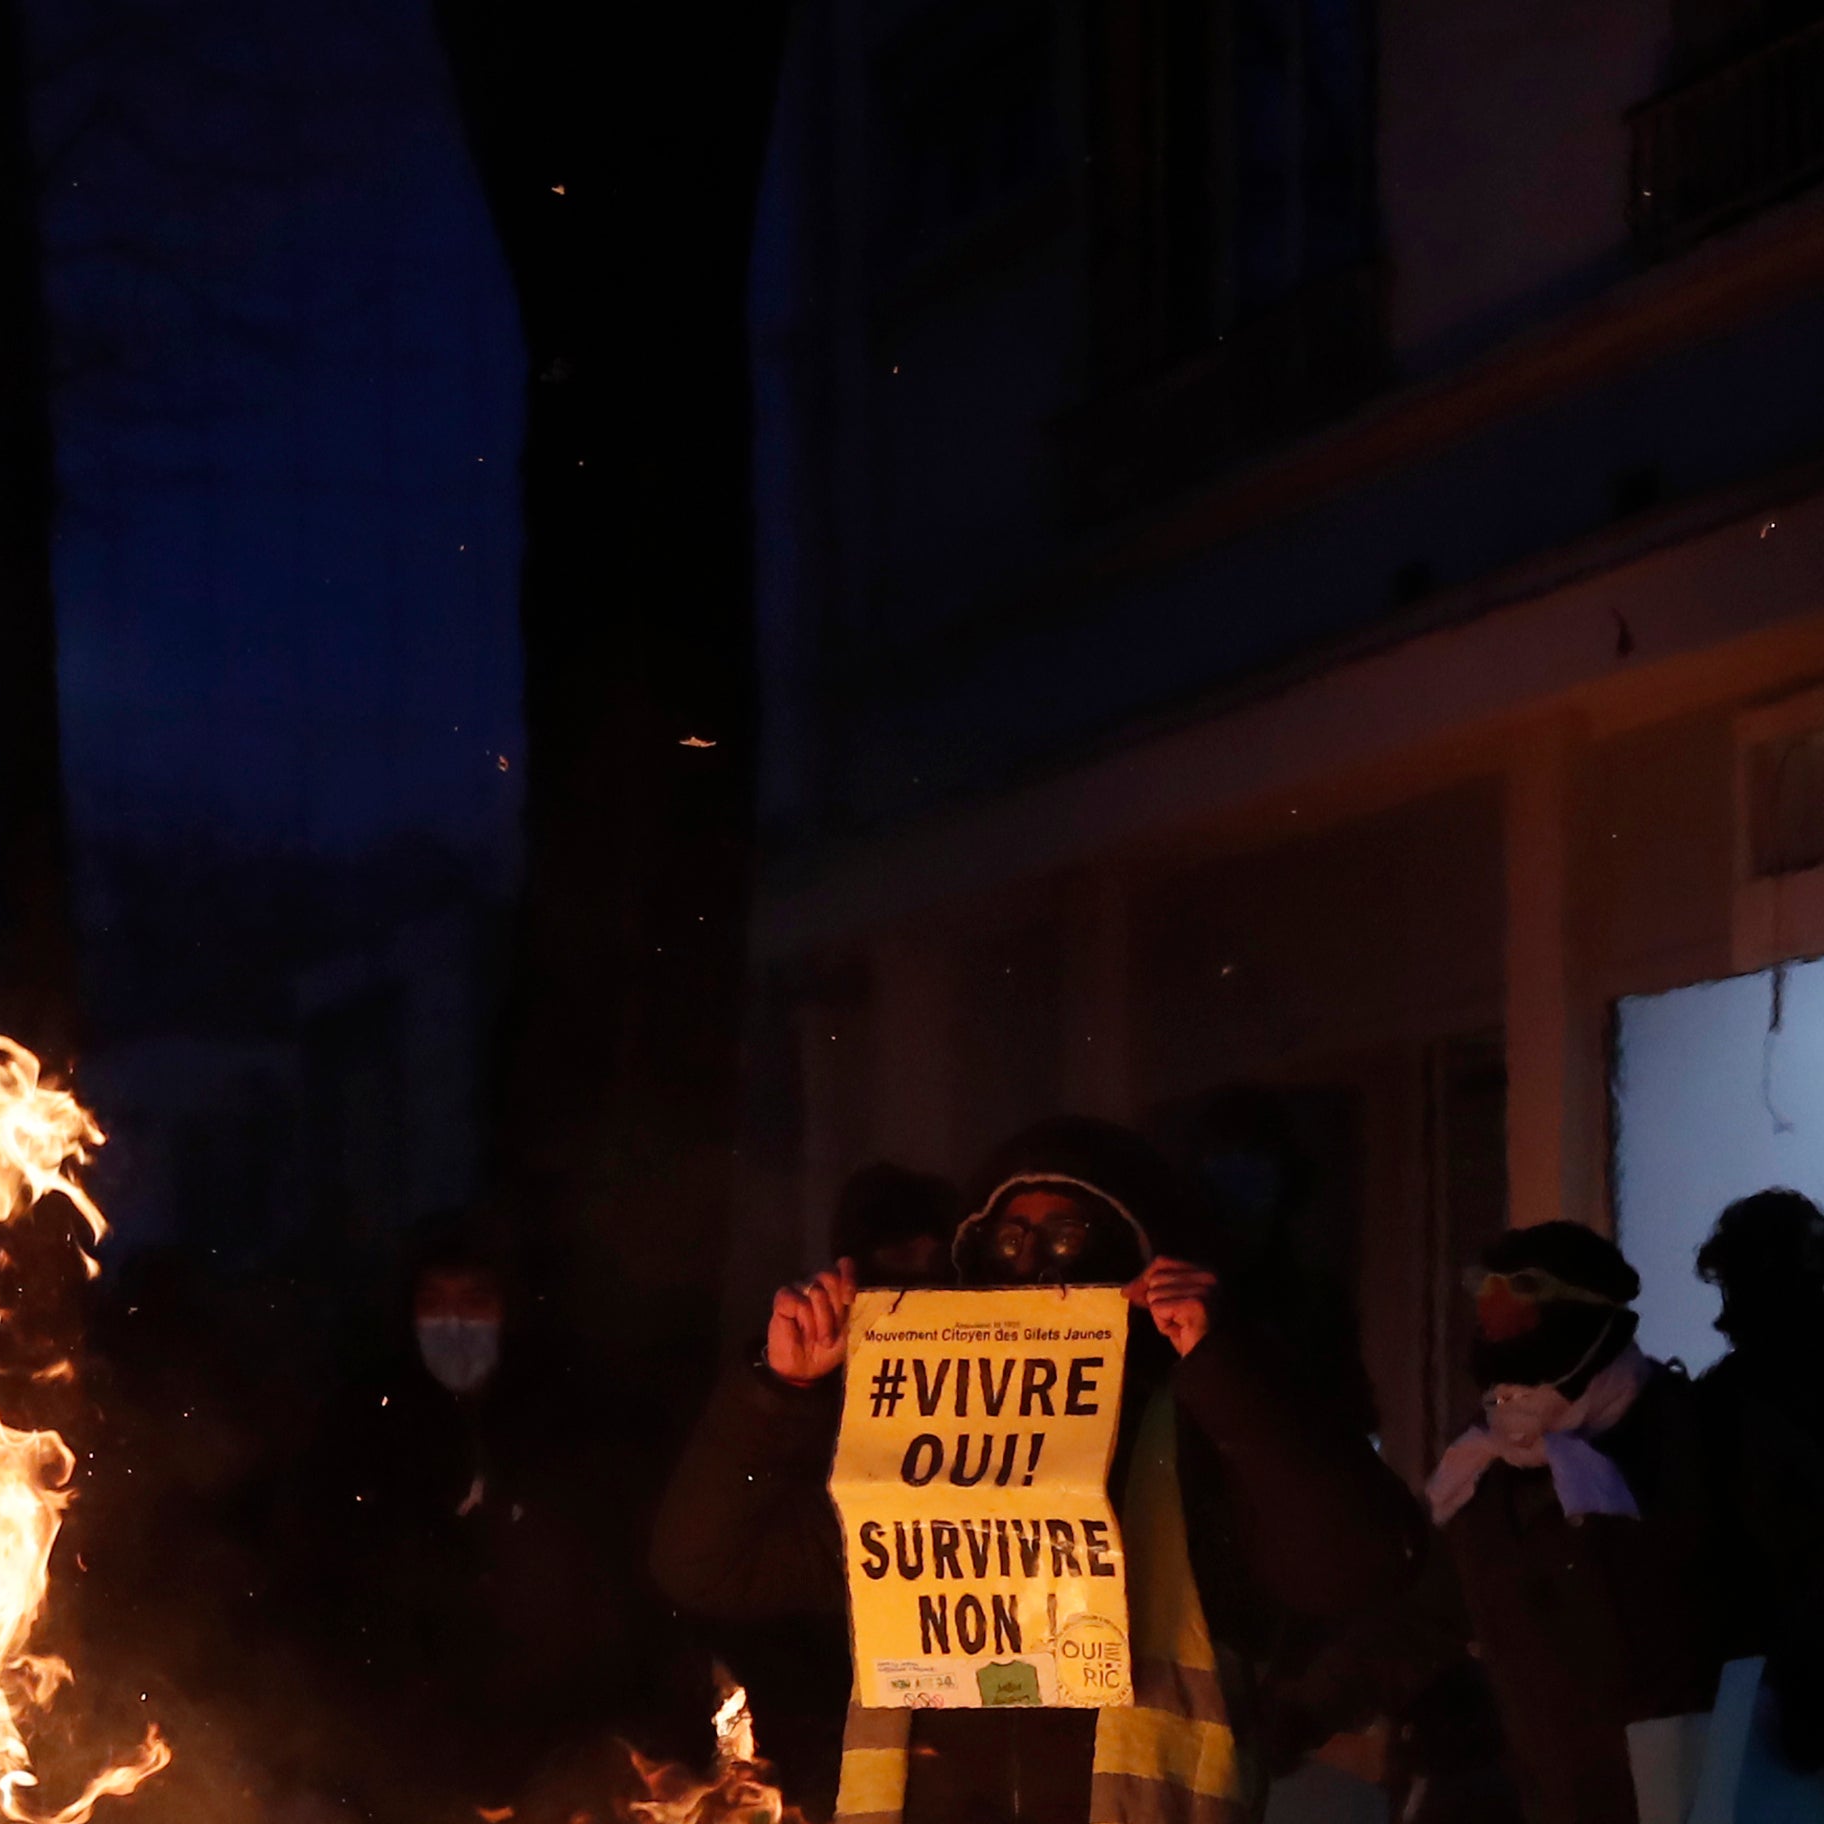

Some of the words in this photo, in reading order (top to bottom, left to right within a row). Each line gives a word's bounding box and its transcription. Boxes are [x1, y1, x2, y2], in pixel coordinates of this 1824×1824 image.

[865, 1329, 938, 1343] Mouvement
[941, 1328, 990, 1343] Citoyen
[994, 1328, 1019, 1342] des
[1024, 1328, 1060, 1341] Gilets
[1063, 1328, 1112, 1341] Jaunes
[870, 1357, 1104, 1418] #VIVRE
[899, 1433, 1046, 1488] OUI!
[859, 1519, 1116, 1581] SURVIVRE
[918, 1594, 1022, 1655] NON
[1083, 1667, 1120, 1689] RIC
